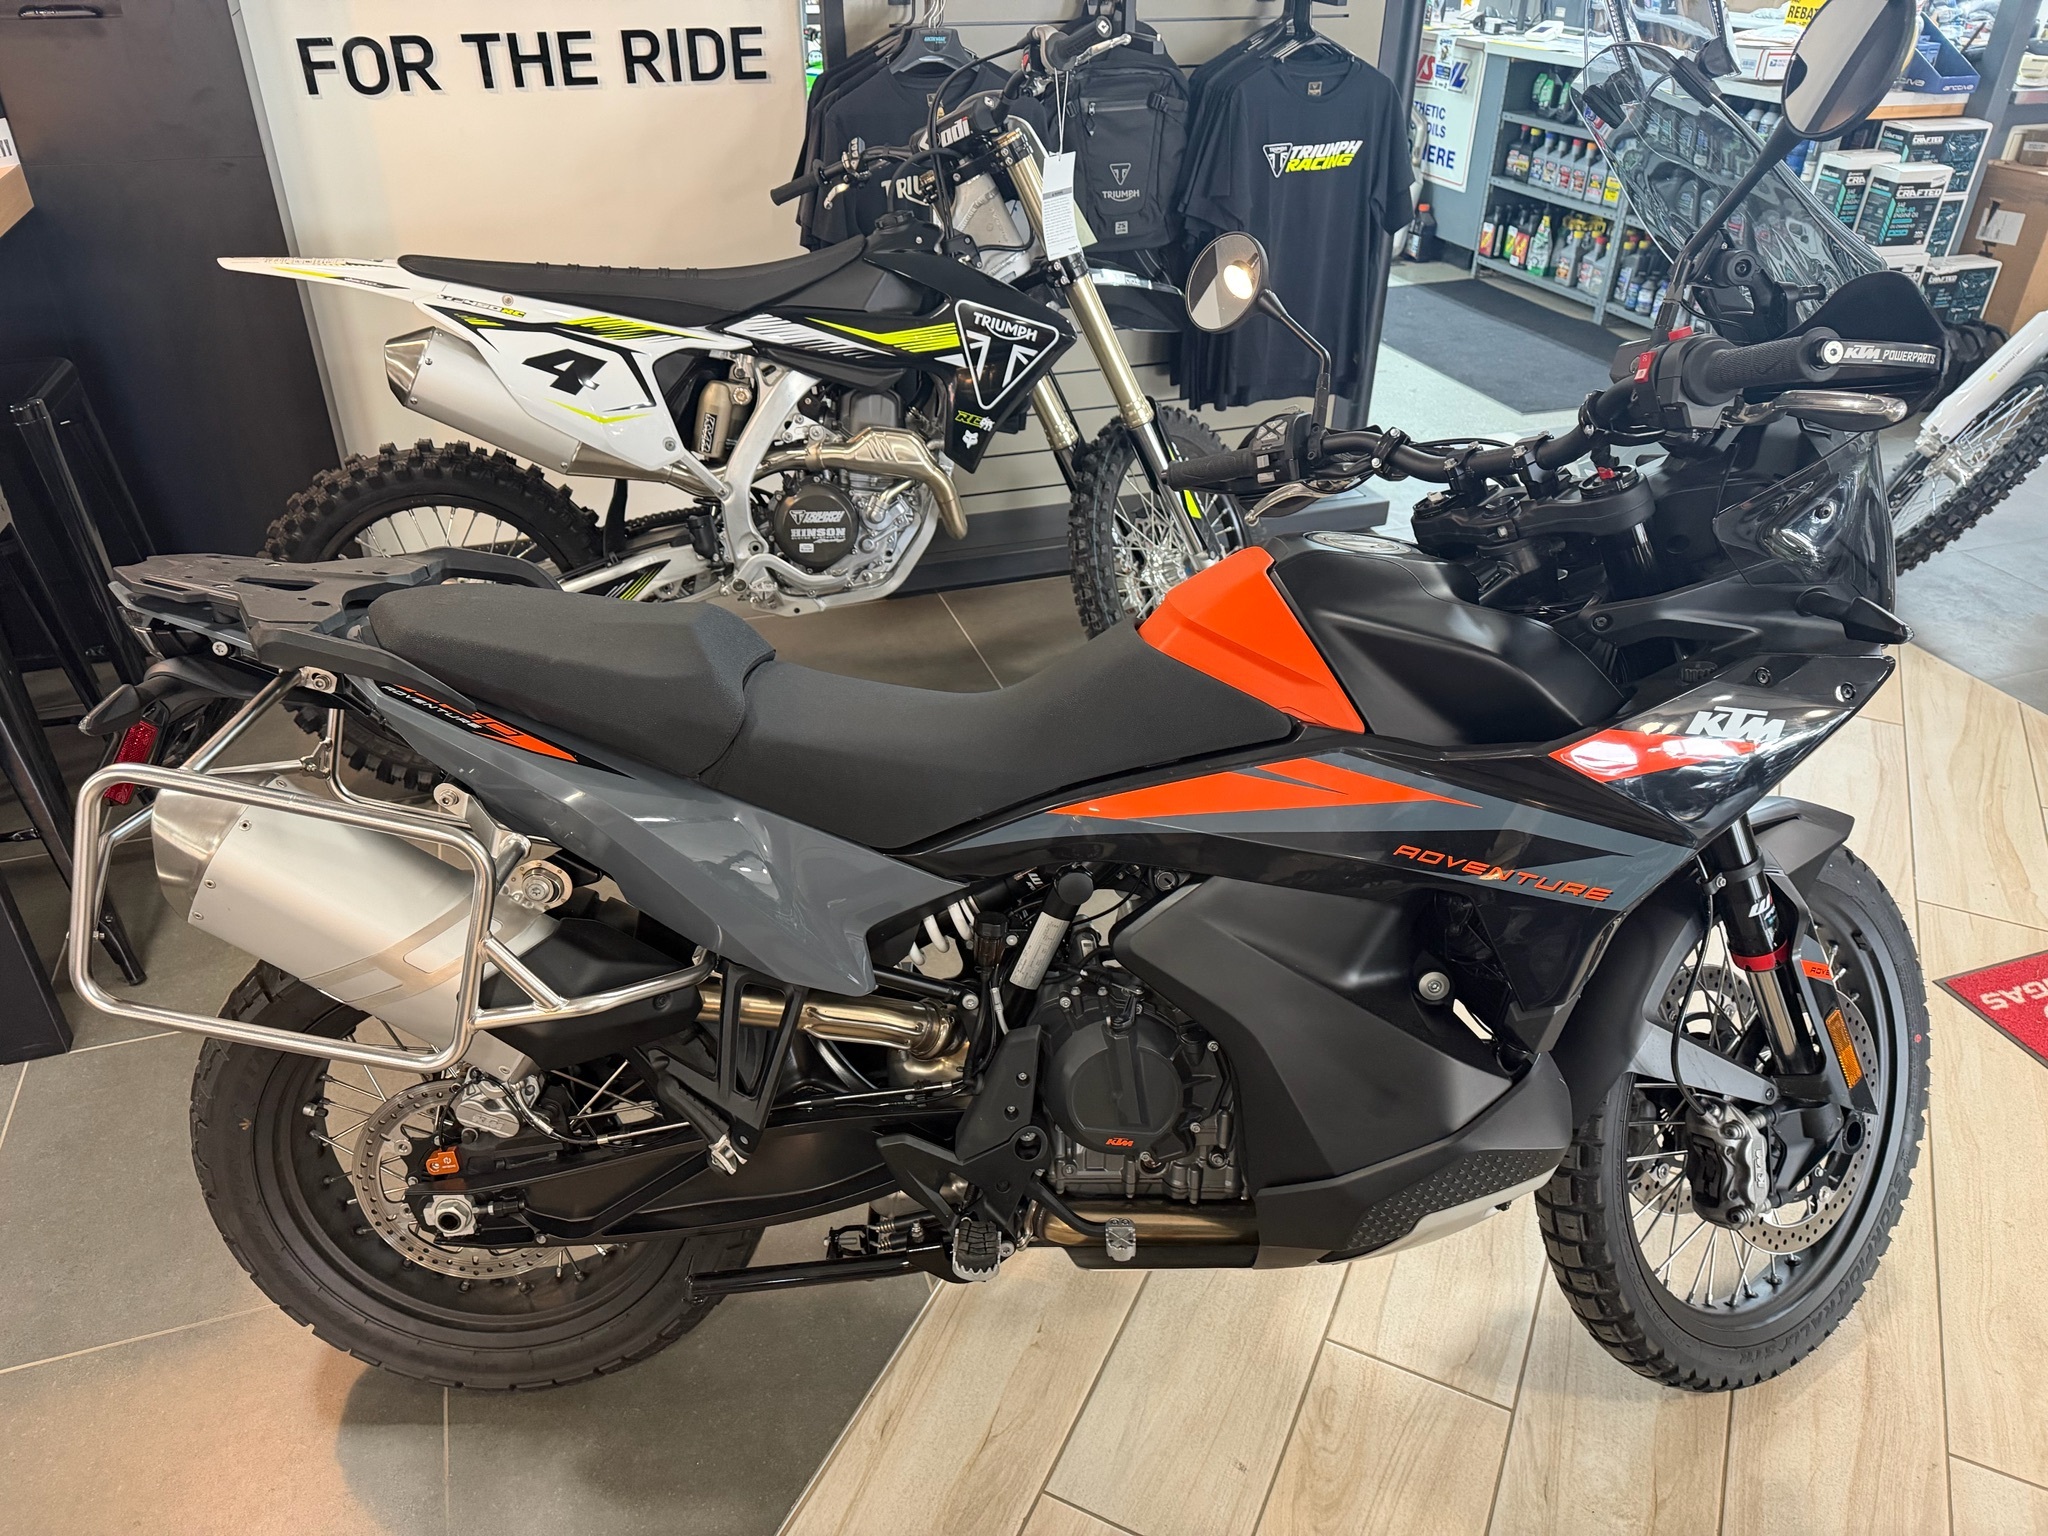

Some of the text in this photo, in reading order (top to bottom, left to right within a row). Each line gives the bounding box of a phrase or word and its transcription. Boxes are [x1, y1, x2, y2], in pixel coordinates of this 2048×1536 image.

[296, 26, 768, 95] FOR THE RIDE
[1285, 153, 1355, 173] RACING
[1290, 140, 1363, 160] TRIUMPH
[1102, 189, 1140, 202] TRIUMPH
[1896, 188, 1942, 199] CRAFTED
[973, 312, 1038, 342] TRIUMPH
[1843, 344, 1936, 365] KTM POWERPARTS
[522, 348, 608, 396] 4
[790, 528, 846, 537] HINSON
[381, 685, 483, 730] ADVENTURE
[1685, 706, 1786, 742] KTM
[1393, 844, 1614, 902] ADVENTURE
[1979, 978, 2048, 1011] GAS
[1105, 1137, 1134, 1147] KTM
[1838, 1172, 1904, 1305] SCORPION
